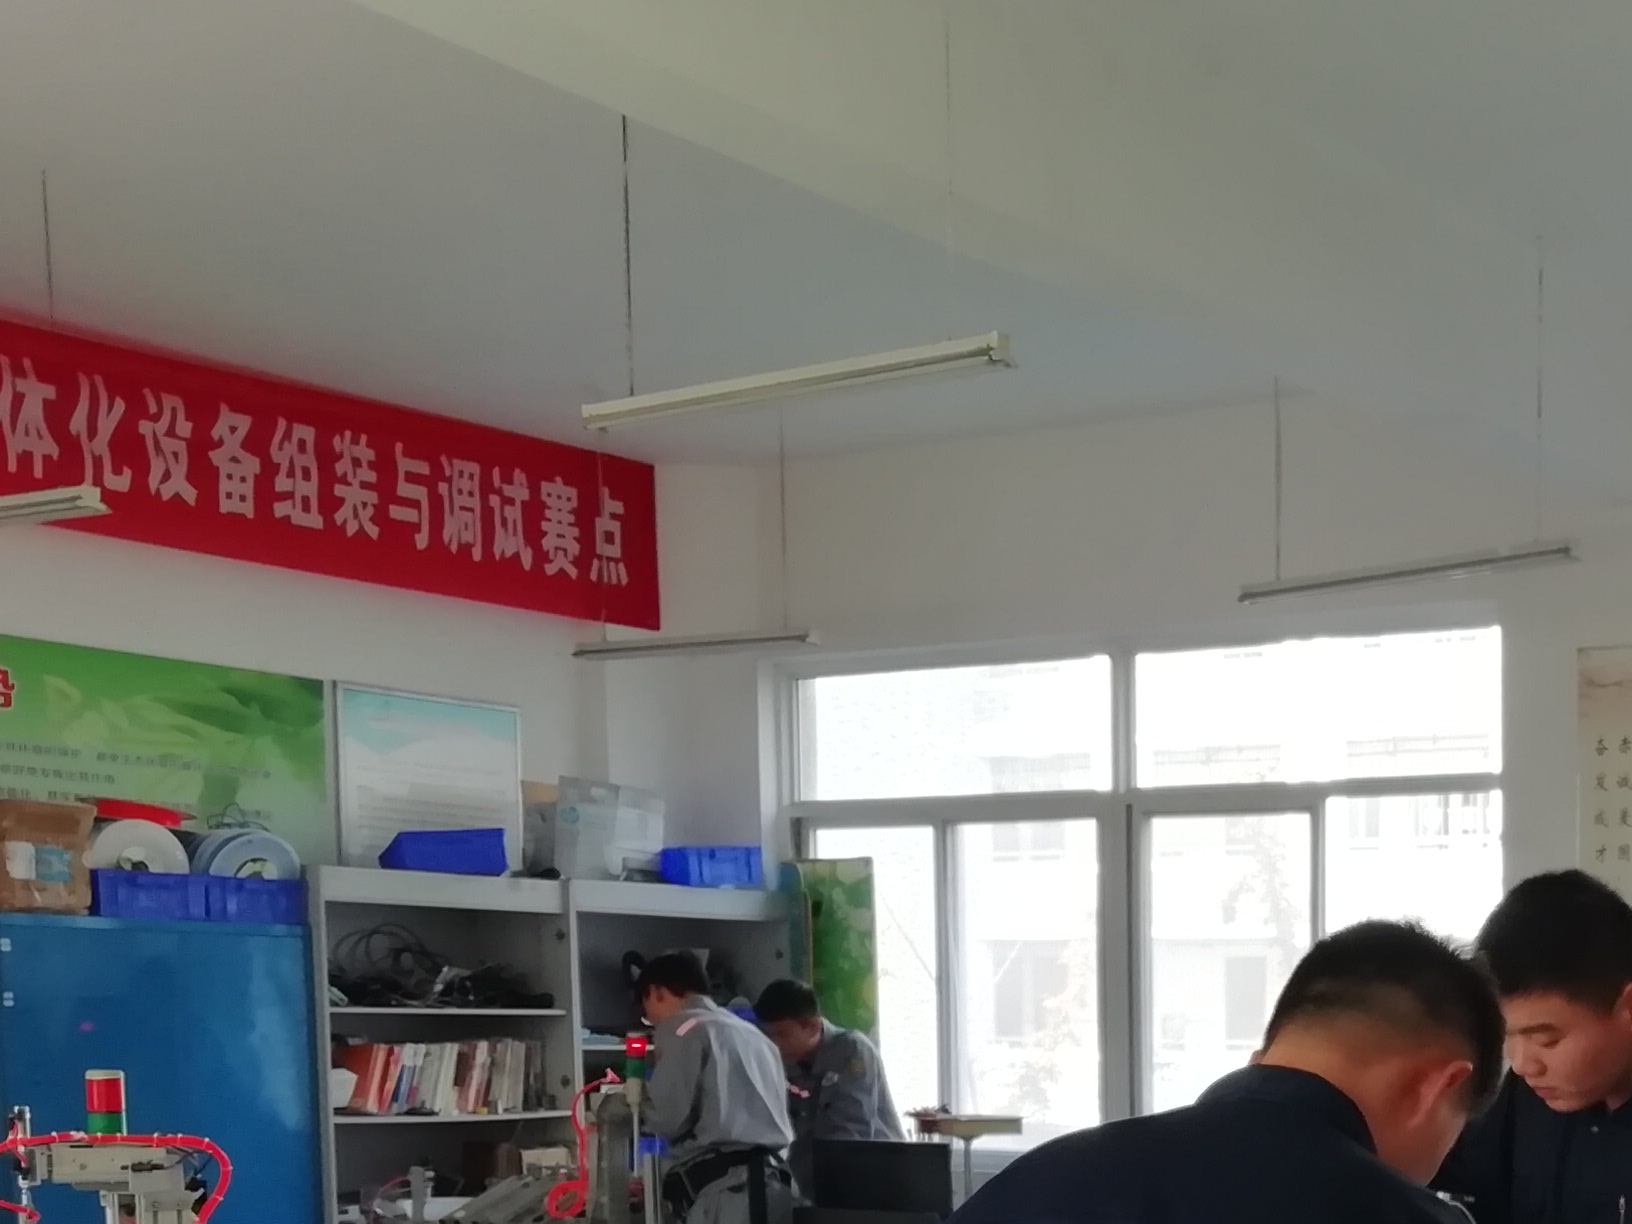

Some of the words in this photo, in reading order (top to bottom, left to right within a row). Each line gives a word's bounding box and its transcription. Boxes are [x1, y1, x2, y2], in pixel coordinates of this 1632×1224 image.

[0, 355, 629, 586] 体化设备组装与调试赛点
